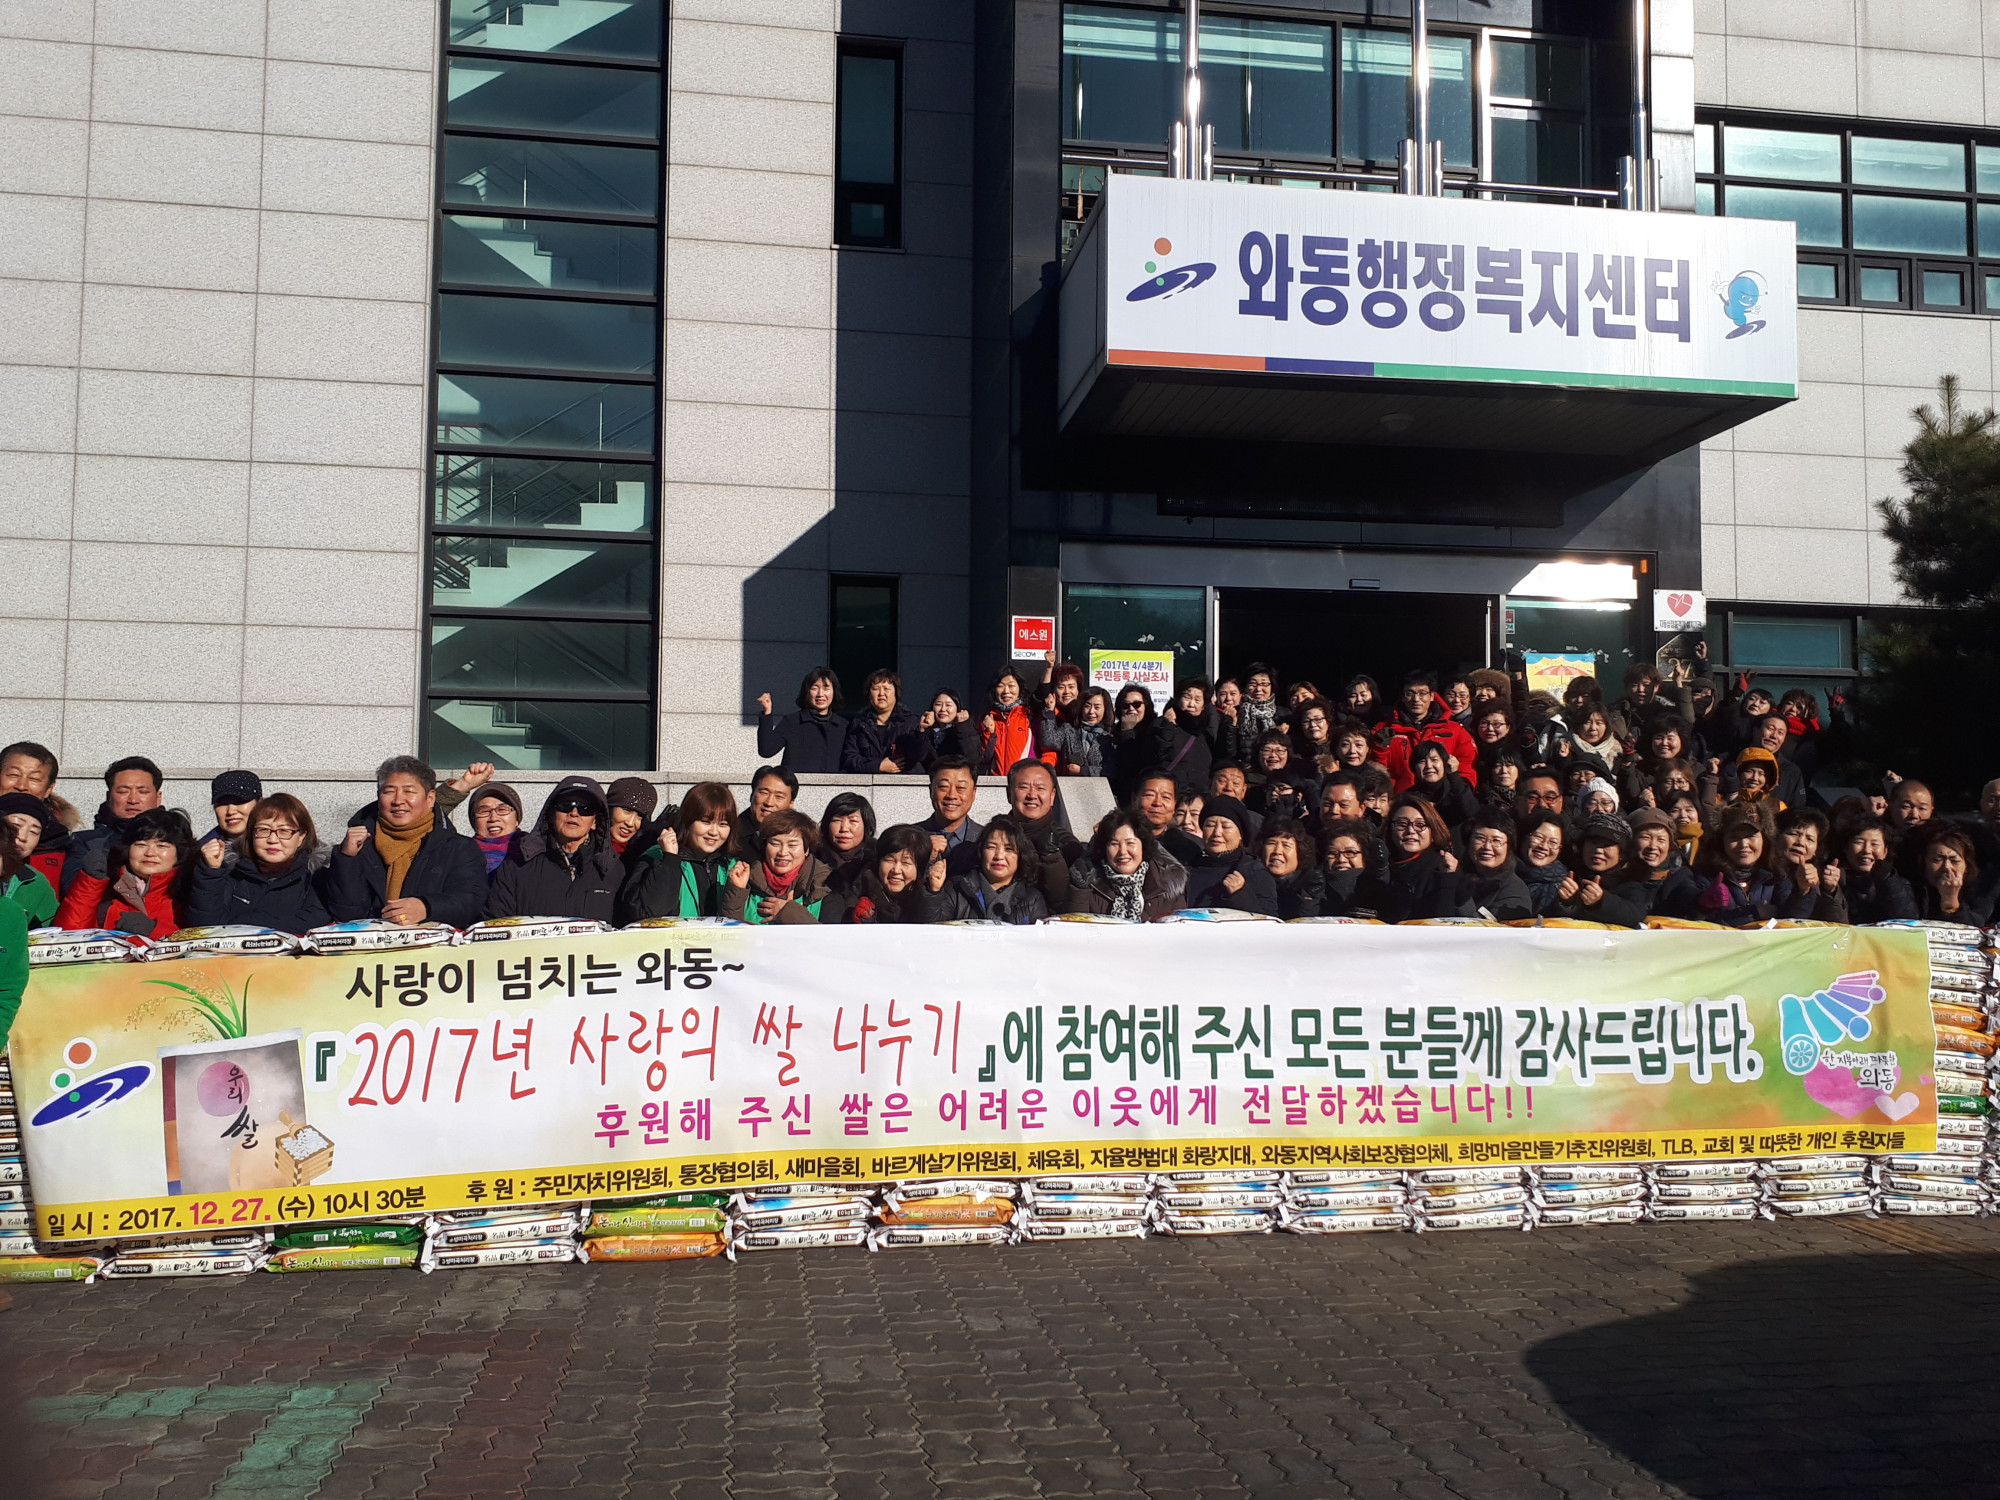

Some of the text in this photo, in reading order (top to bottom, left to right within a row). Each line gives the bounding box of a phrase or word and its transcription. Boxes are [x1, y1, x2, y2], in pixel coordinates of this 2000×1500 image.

[1239, 231, 1690, 342] 와동행정복지센터
[1019, 629, 1048, 641] 에스원
[1094, 670, 1170, 683] 주민등록 사실조사
[1101, 660, 1163, 671] 2017년 4/4분기
[346, 948, 744, 1008] 사랑이 넘치는 와동~
[570, 1006, 719, 1091] 사랑의
[753, 1003, 802, 1086] 쌀
[1056, 1005, 1180, 1081] 참여해
[1192, 1005, 1274, 1079] 주신
[1287, 1007, 1369, 1078] 모든
[1384, 1007, 1502, 1079] 분들께
[1515, 1003, 1756, 1078] 감사드립니다.
[228, 1065, 243, 1103] 우리
[221, 1104, 258, 1149] 쌀
[595, 1084, 1532, 1148] 후원해 주신 쌀은 어려운 이웃에게 전달하겠습니다!!
[533, 1167, 672, 1197] 주민자치위원회,
[679, 1159, 781, 1189] 통장협의회,
[785, 1157, 862, 1182] 새마을회,
[872, 1151, 1021, 1178] 바르게살기위원회,
[1028, 1149, 1084, 1173] 체육회,
[1091, 1147, 1177, 1168] 자율방범대
[1183, 1145, 1256, 1165] 화랑지대,
[1262, 1144, 1453, 1166] 와동지역사회보장협의체,
[1458, 1139, 1656, 1160] 희망마을만들기추진위원회,
[1662, 1139, 1697, 1155] TLB,
[1702, 1136, 1733, 1154] 교회
[1740, 1135, 1754, 1153] 및
[1760, 1133, 1802, 1154] 따뜻한
[1806, 1132, 1837, 1149] 개인
[1840, 1131, 1905, 1153] 후원자들
[119, 1207, 184, 1232] 2017.
[190, 1202, 224, 1224] 12.
[232, 1198, 270, 1221] 27.
[278, 1194, 317, 1222] (수)
[324, 1191, 372, 1216] 10시
[377, 1186, 426, 1212] 30분
